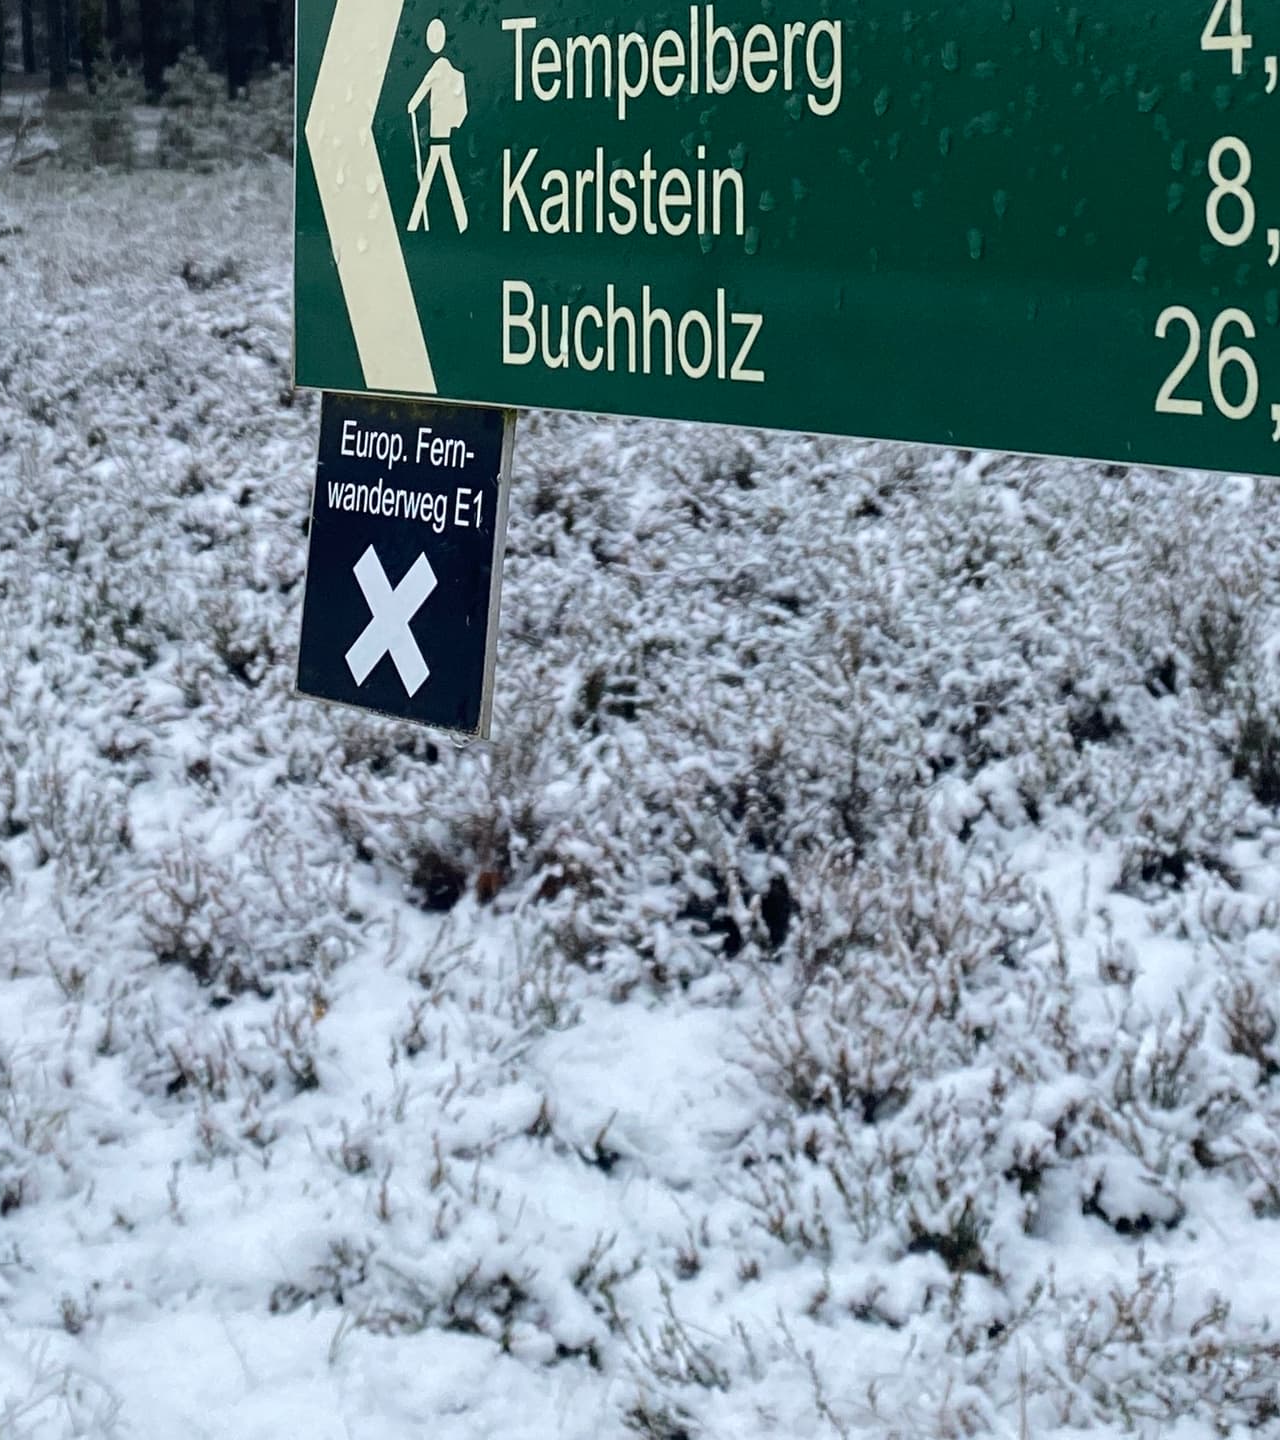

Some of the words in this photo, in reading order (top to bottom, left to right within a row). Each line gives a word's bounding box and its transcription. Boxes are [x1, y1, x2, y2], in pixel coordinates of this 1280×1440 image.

[501, 4, 842, 120] Tempelberg
[502, 145, 745, 237] Karlstein
[501, 280, 765, 382] Buchholz
[340, 419, 407, 470] Europ.
[416, 427, 475, 469] Fern-
[327, 478, 448, 534] wanderweg
[454, 488, 484, 528] E1
